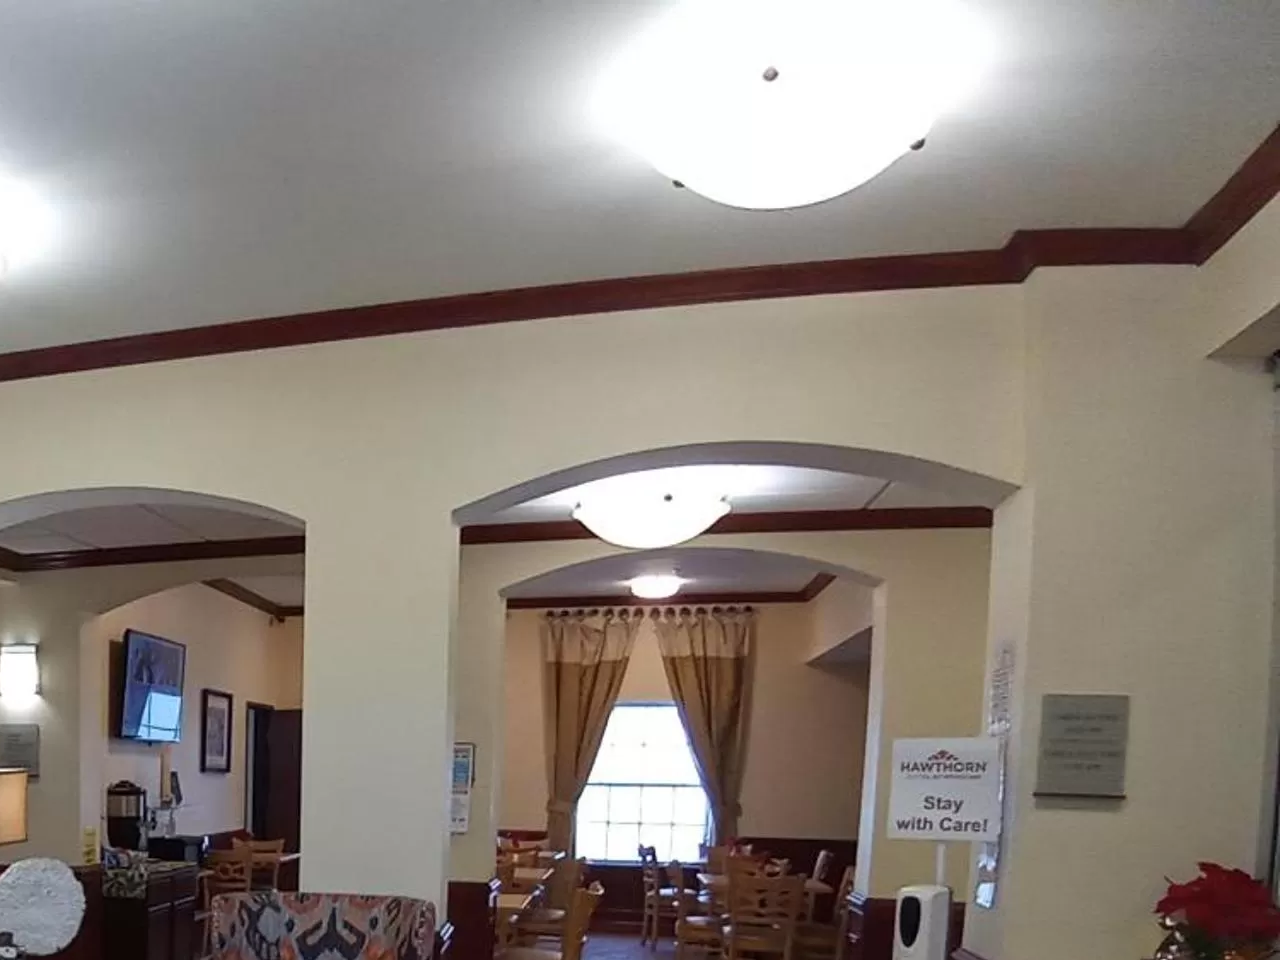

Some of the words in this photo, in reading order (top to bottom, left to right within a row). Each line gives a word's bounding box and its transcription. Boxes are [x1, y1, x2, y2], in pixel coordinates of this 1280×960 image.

[900, 761, 989, 774] HAWTHORN
[923, 795, 965, 814] Stay
[896, 816, 934, 832] with
[939, 817, 989, 833] Care!
